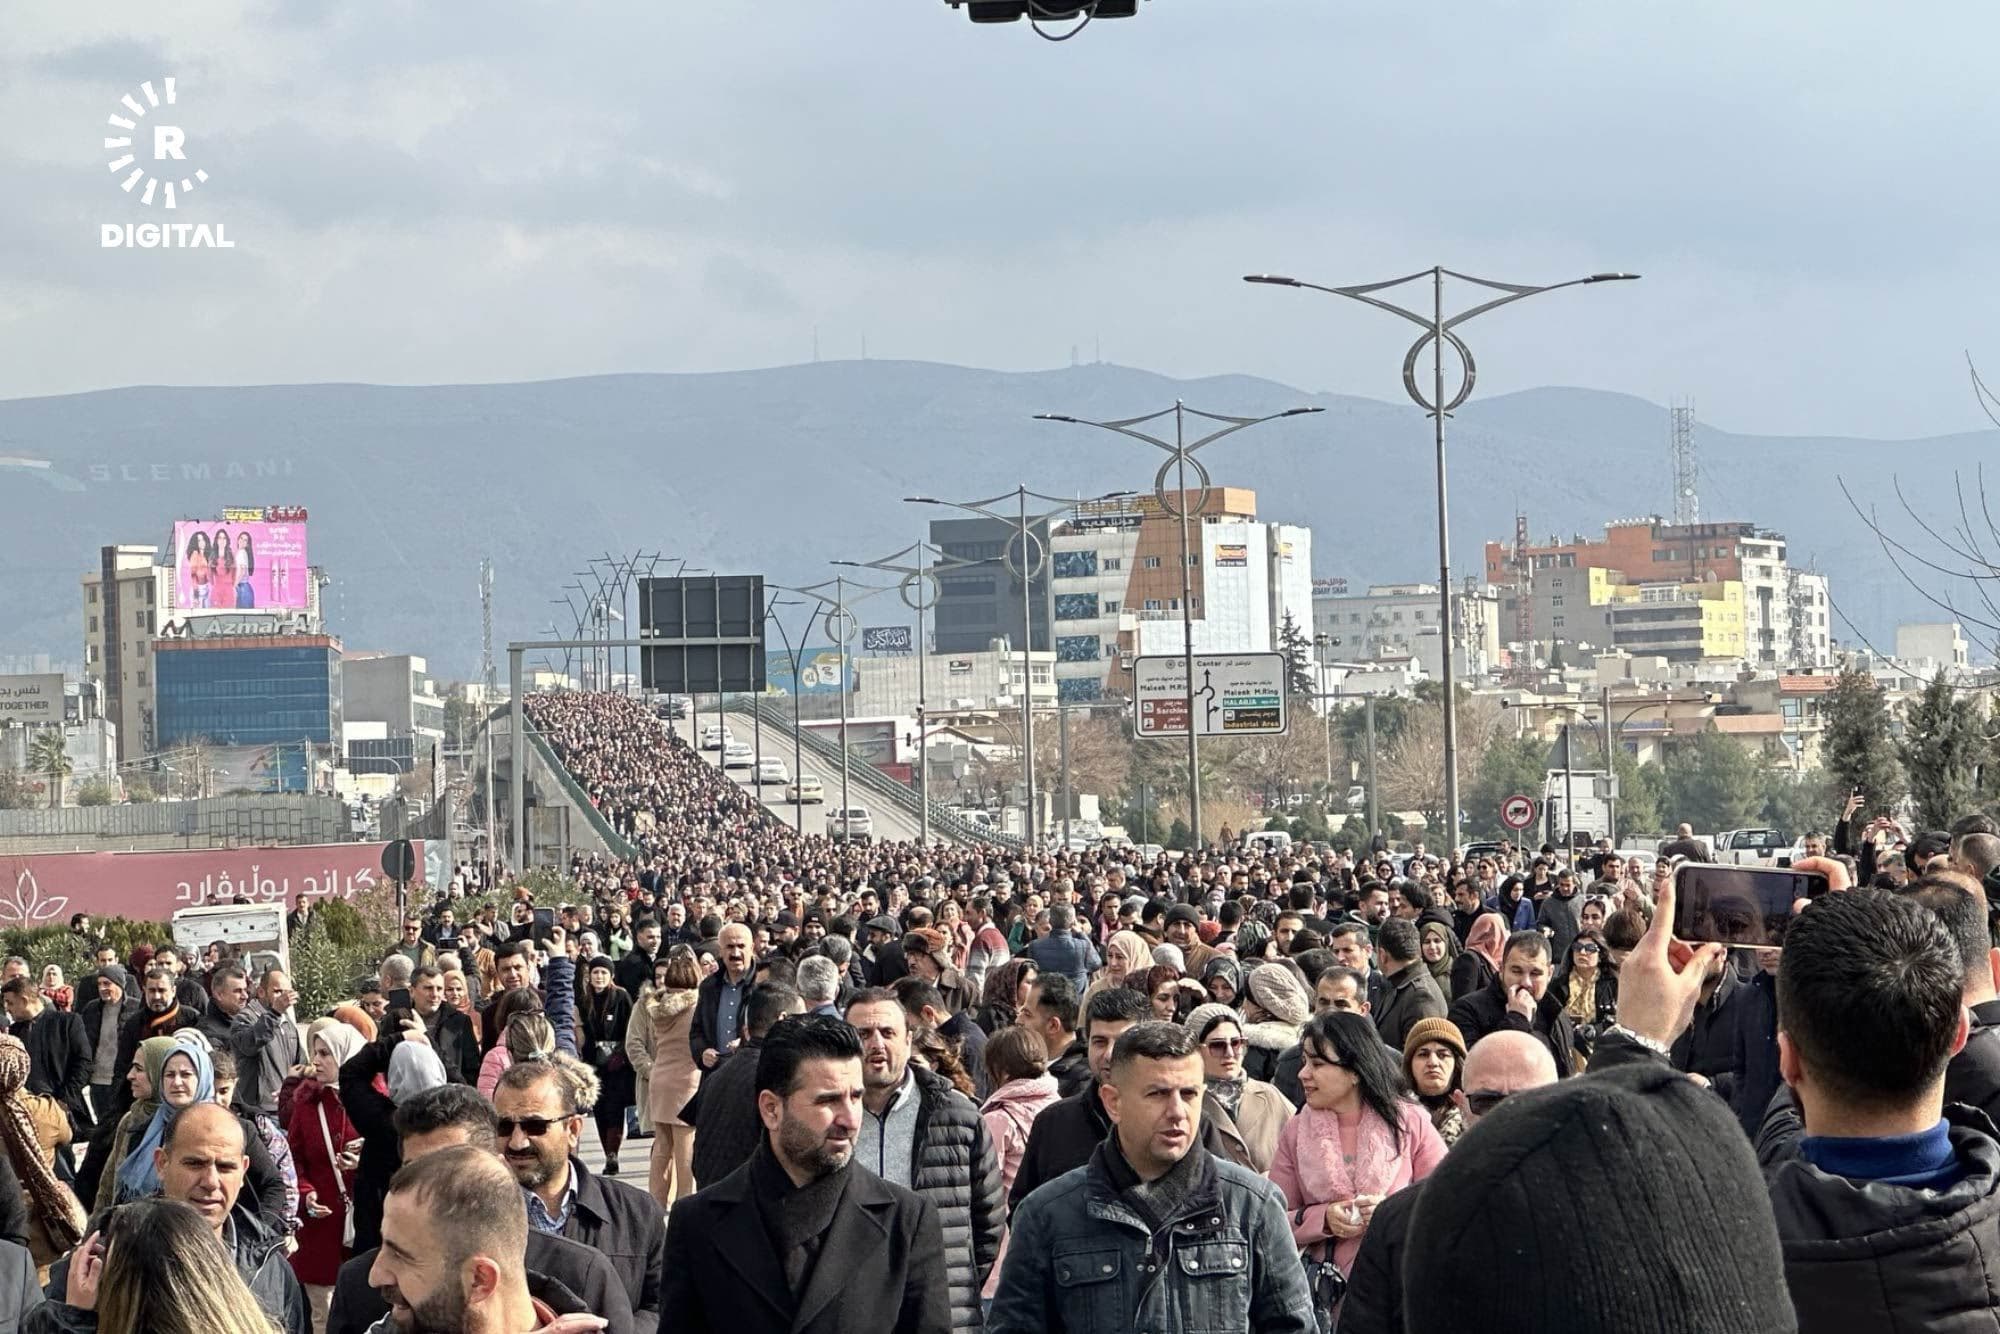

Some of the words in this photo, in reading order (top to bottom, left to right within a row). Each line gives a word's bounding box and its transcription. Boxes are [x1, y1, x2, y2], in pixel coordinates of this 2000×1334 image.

[88, 459, 296, 481] SLEMANI
[205, 619, 286, 635] Azmar
[0, 701, 48, 710] TOGETHER
[303, 867, 376, 900] گراند
